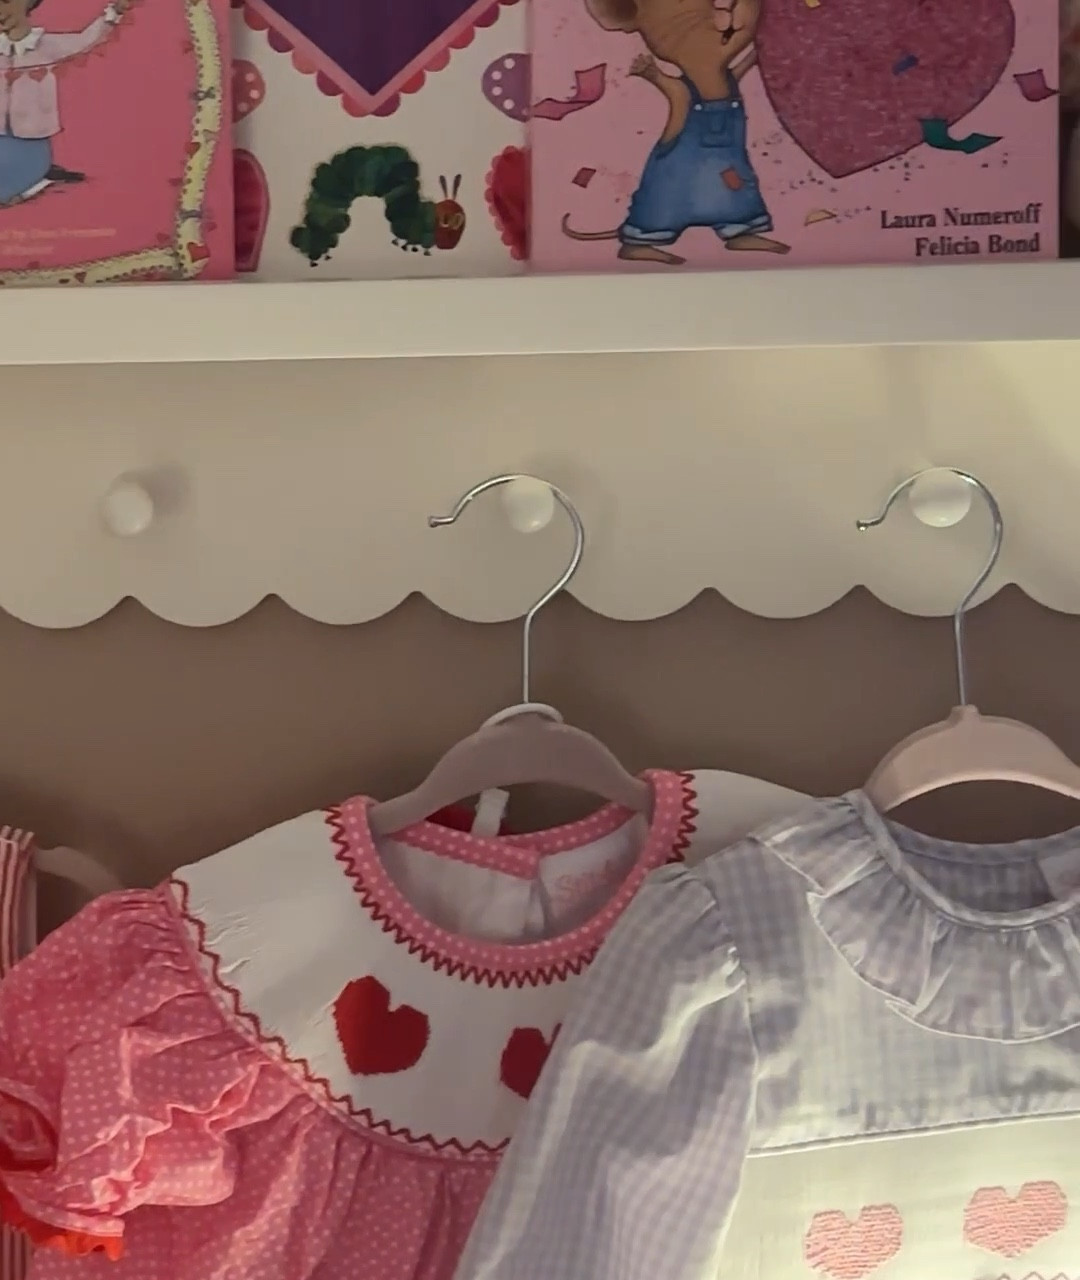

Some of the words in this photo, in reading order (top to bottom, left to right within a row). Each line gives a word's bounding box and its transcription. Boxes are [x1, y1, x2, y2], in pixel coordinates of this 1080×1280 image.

[880, 209, 937, 229] Laura
[943, 202, 1043, 227] Numeroff
[915, 235, 981, 257] Felicia
[988, 232, 1041, 254] Bond
